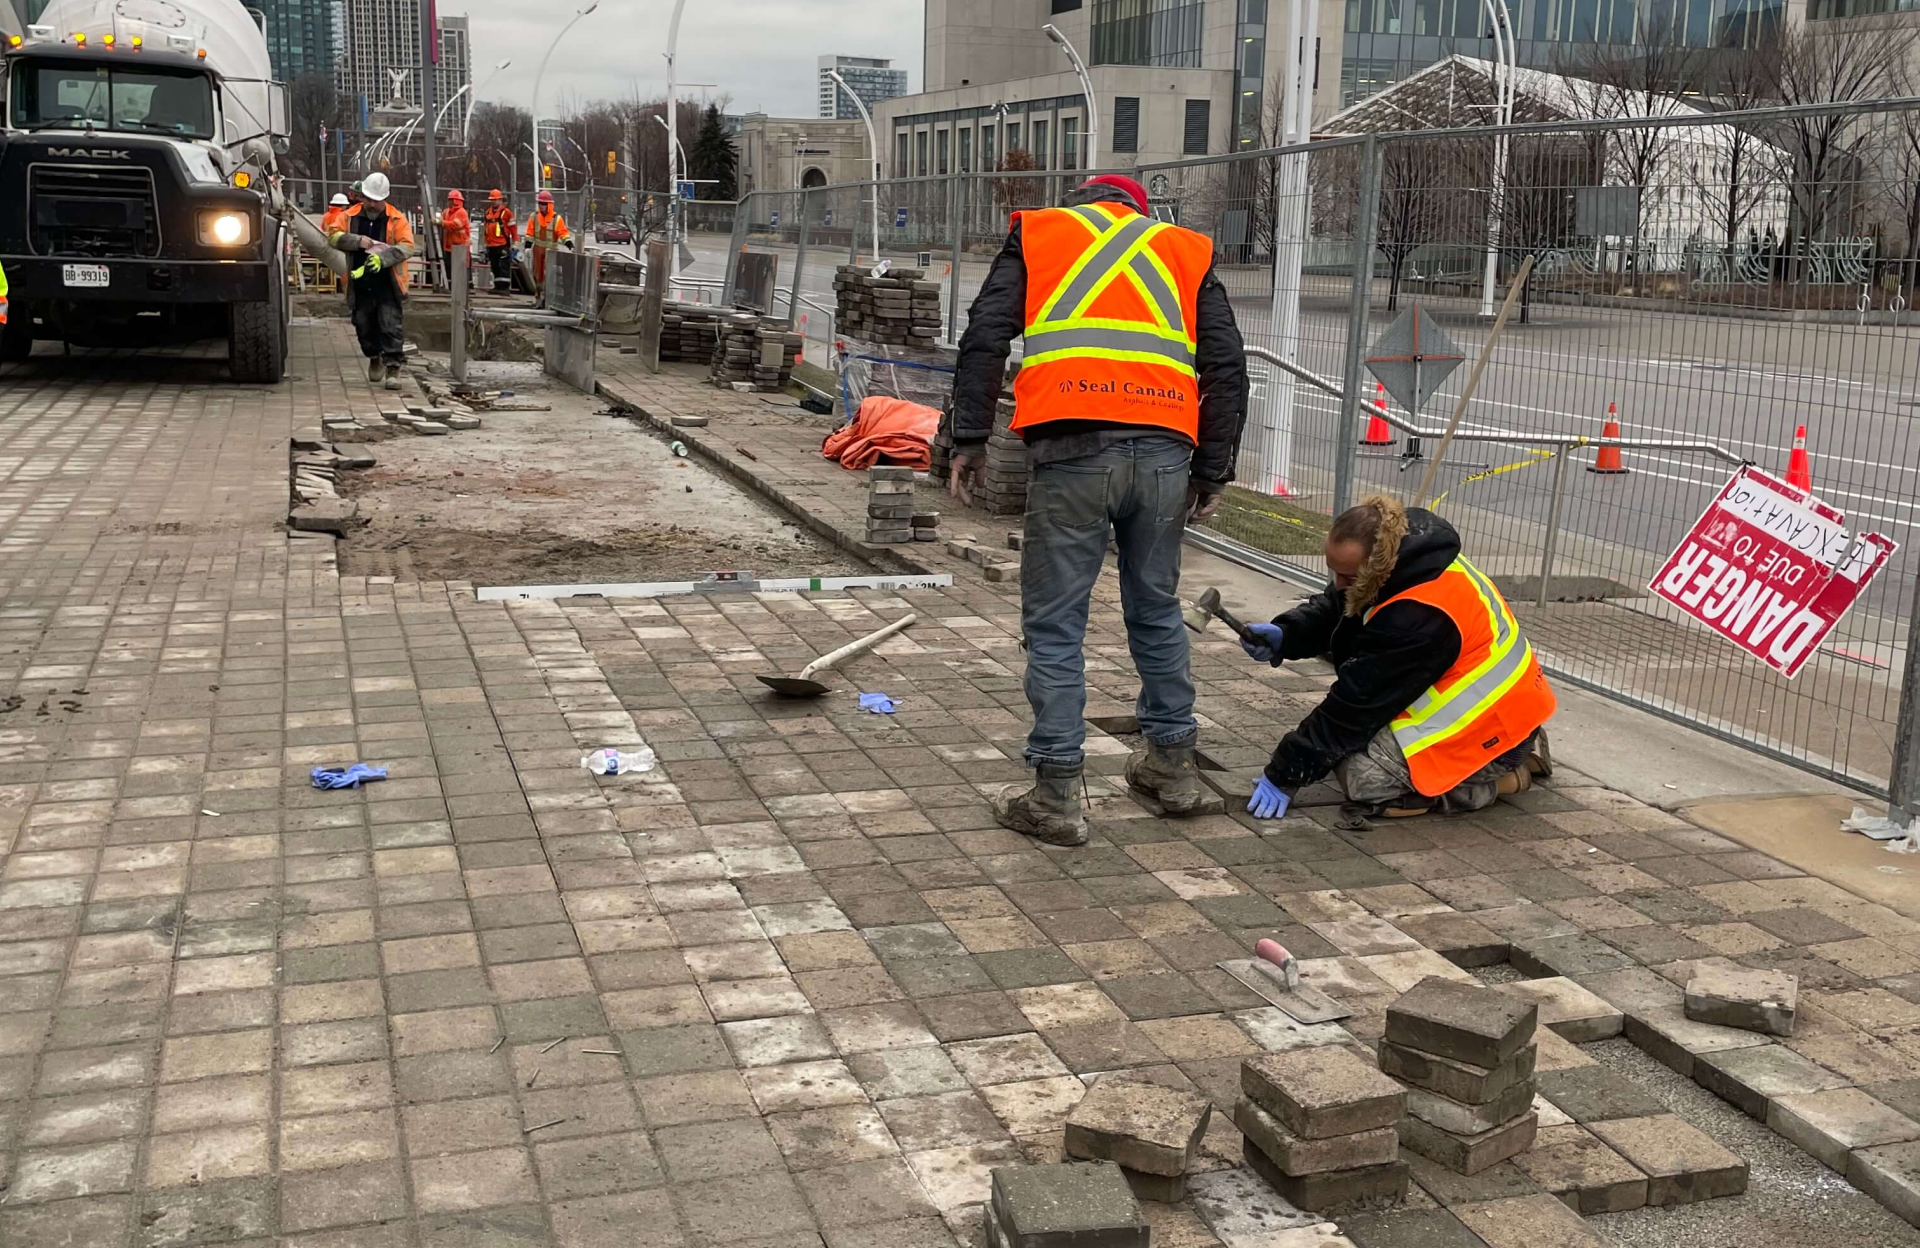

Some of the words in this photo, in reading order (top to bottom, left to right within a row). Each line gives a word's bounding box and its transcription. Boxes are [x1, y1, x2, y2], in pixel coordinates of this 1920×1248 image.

[47, 147, 131, 160] MACK
[1078, 379, 1116, 393] Seal
[1123, 382, 1184, 402] Canada
[1732, 535, 1761, 564] TO
[1757, 550, 1805, 586] DUE
[1662, 541, 1826, 664] DANGER
